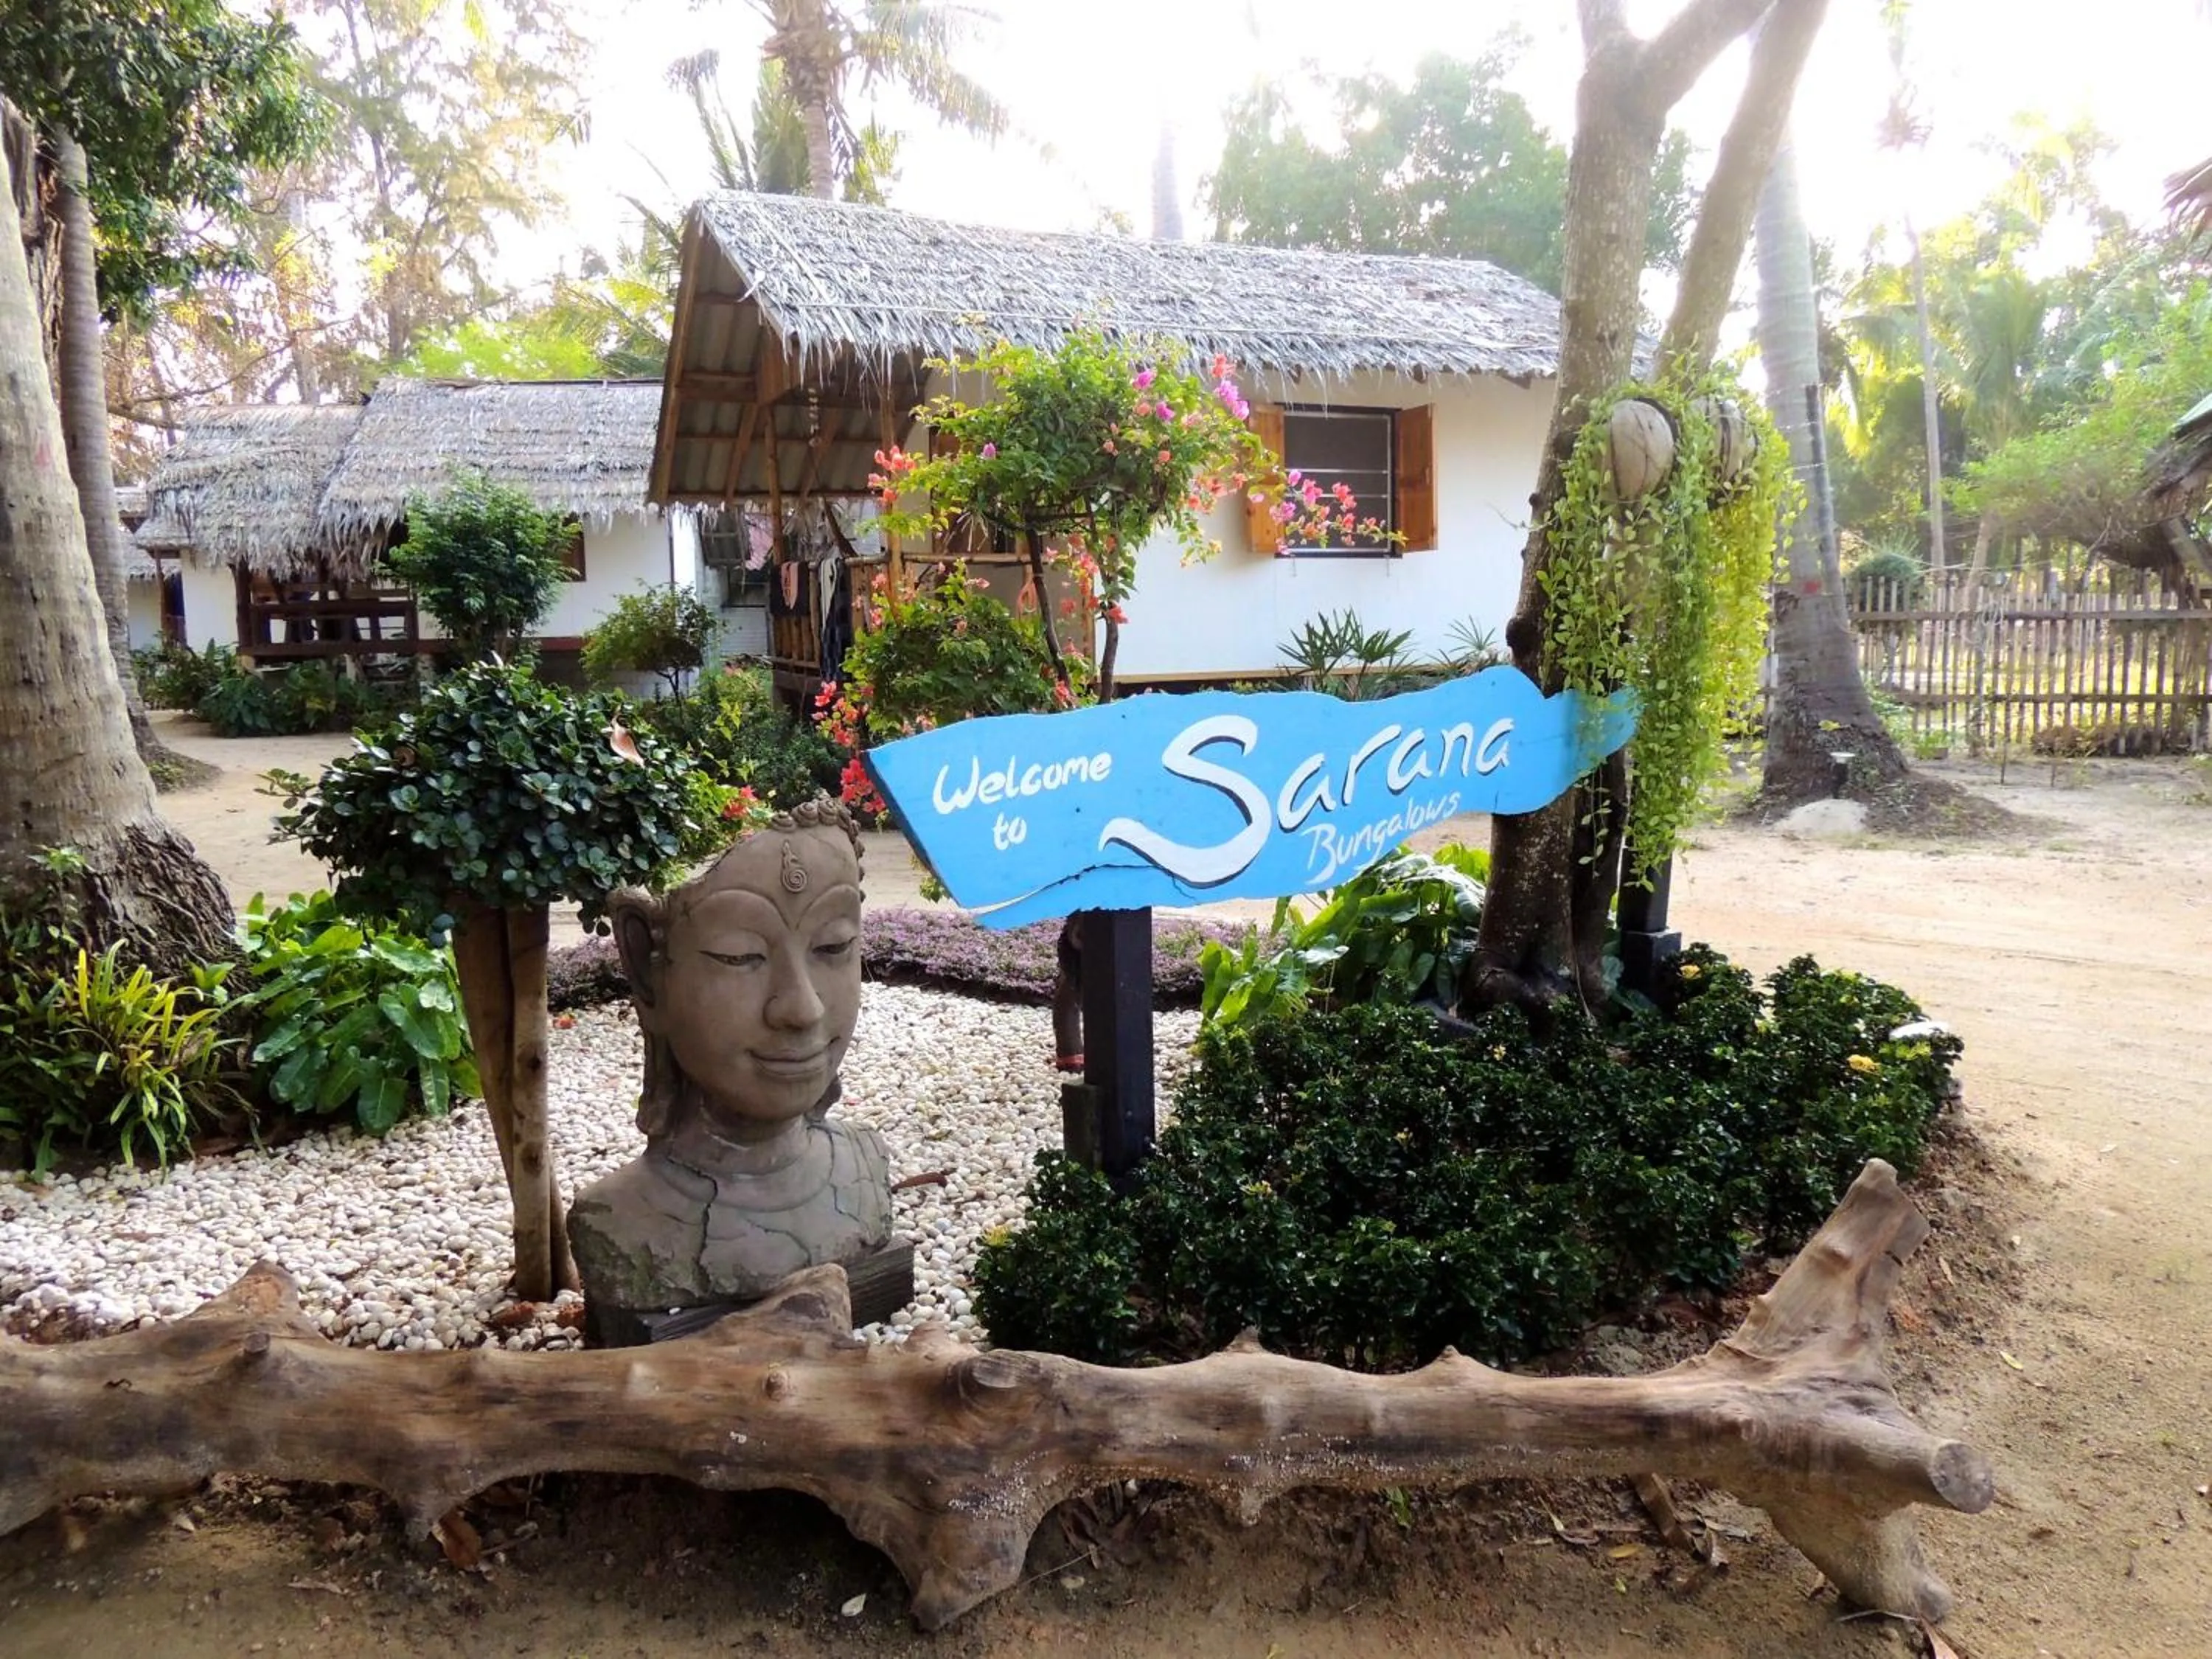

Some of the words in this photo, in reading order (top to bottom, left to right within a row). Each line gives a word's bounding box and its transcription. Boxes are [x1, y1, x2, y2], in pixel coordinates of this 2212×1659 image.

[933, 752, 1112, 815] Welcome
[1099, 714, 1514, 887] Sarana
[992, 813, 1027, 850] to
[1301, 791, 1461, 884] Bungalows
